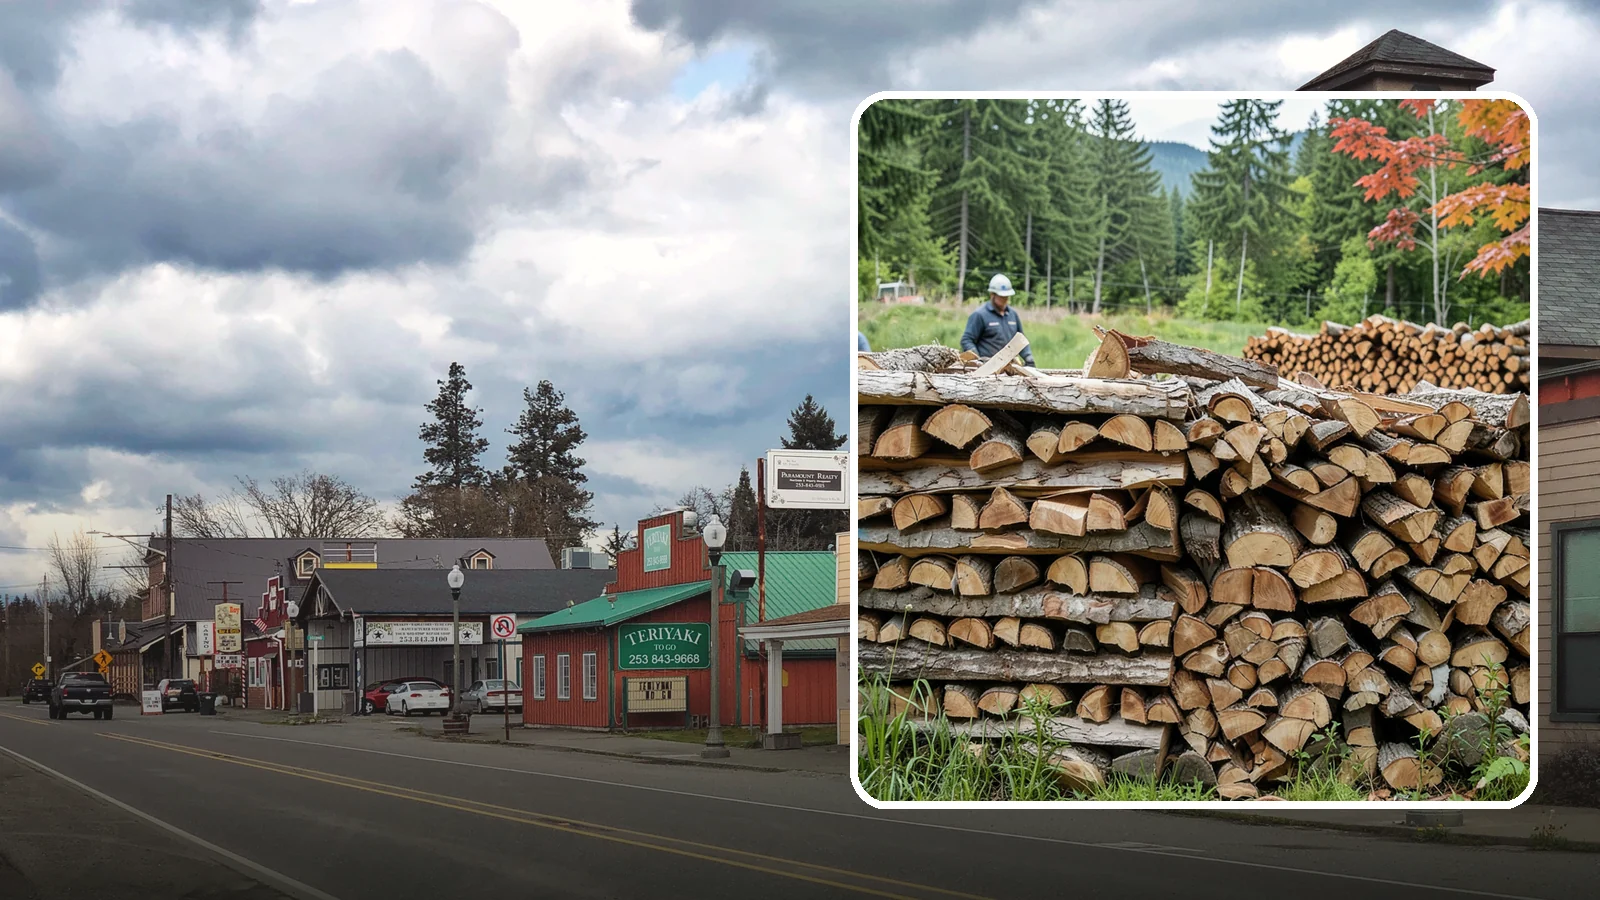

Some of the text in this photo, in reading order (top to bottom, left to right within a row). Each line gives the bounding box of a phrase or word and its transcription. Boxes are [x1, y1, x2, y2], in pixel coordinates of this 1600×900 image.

[625, 627, 702, 646] TERIYAKI
[629, 654, 700, 665] 253 843-9668
